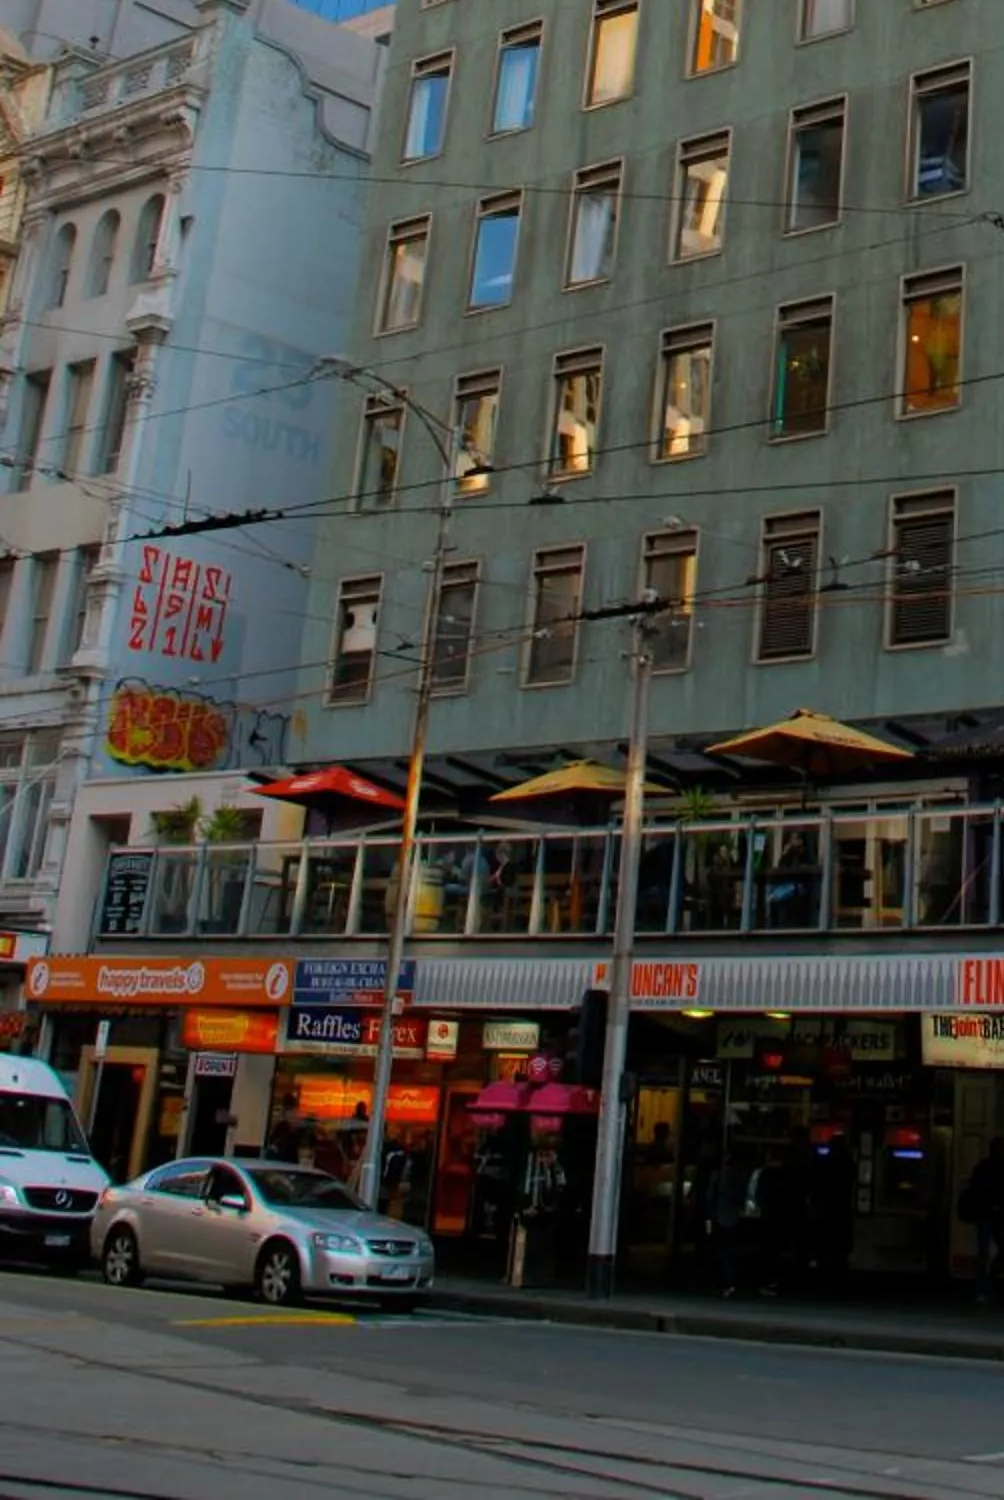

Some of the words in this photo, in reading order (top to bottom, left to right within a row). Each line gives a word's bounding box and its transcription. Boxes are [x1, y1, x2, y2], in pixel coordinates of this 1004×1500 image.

[351, 962, 406, 976] EXCHAE
[631, 963, 698, 997] UNCAN'S
[296, 1012, 361, 1040] Raffles
[367, 1018, 417, 1044] Frex
[932, 1014, 955, 1037] THE
